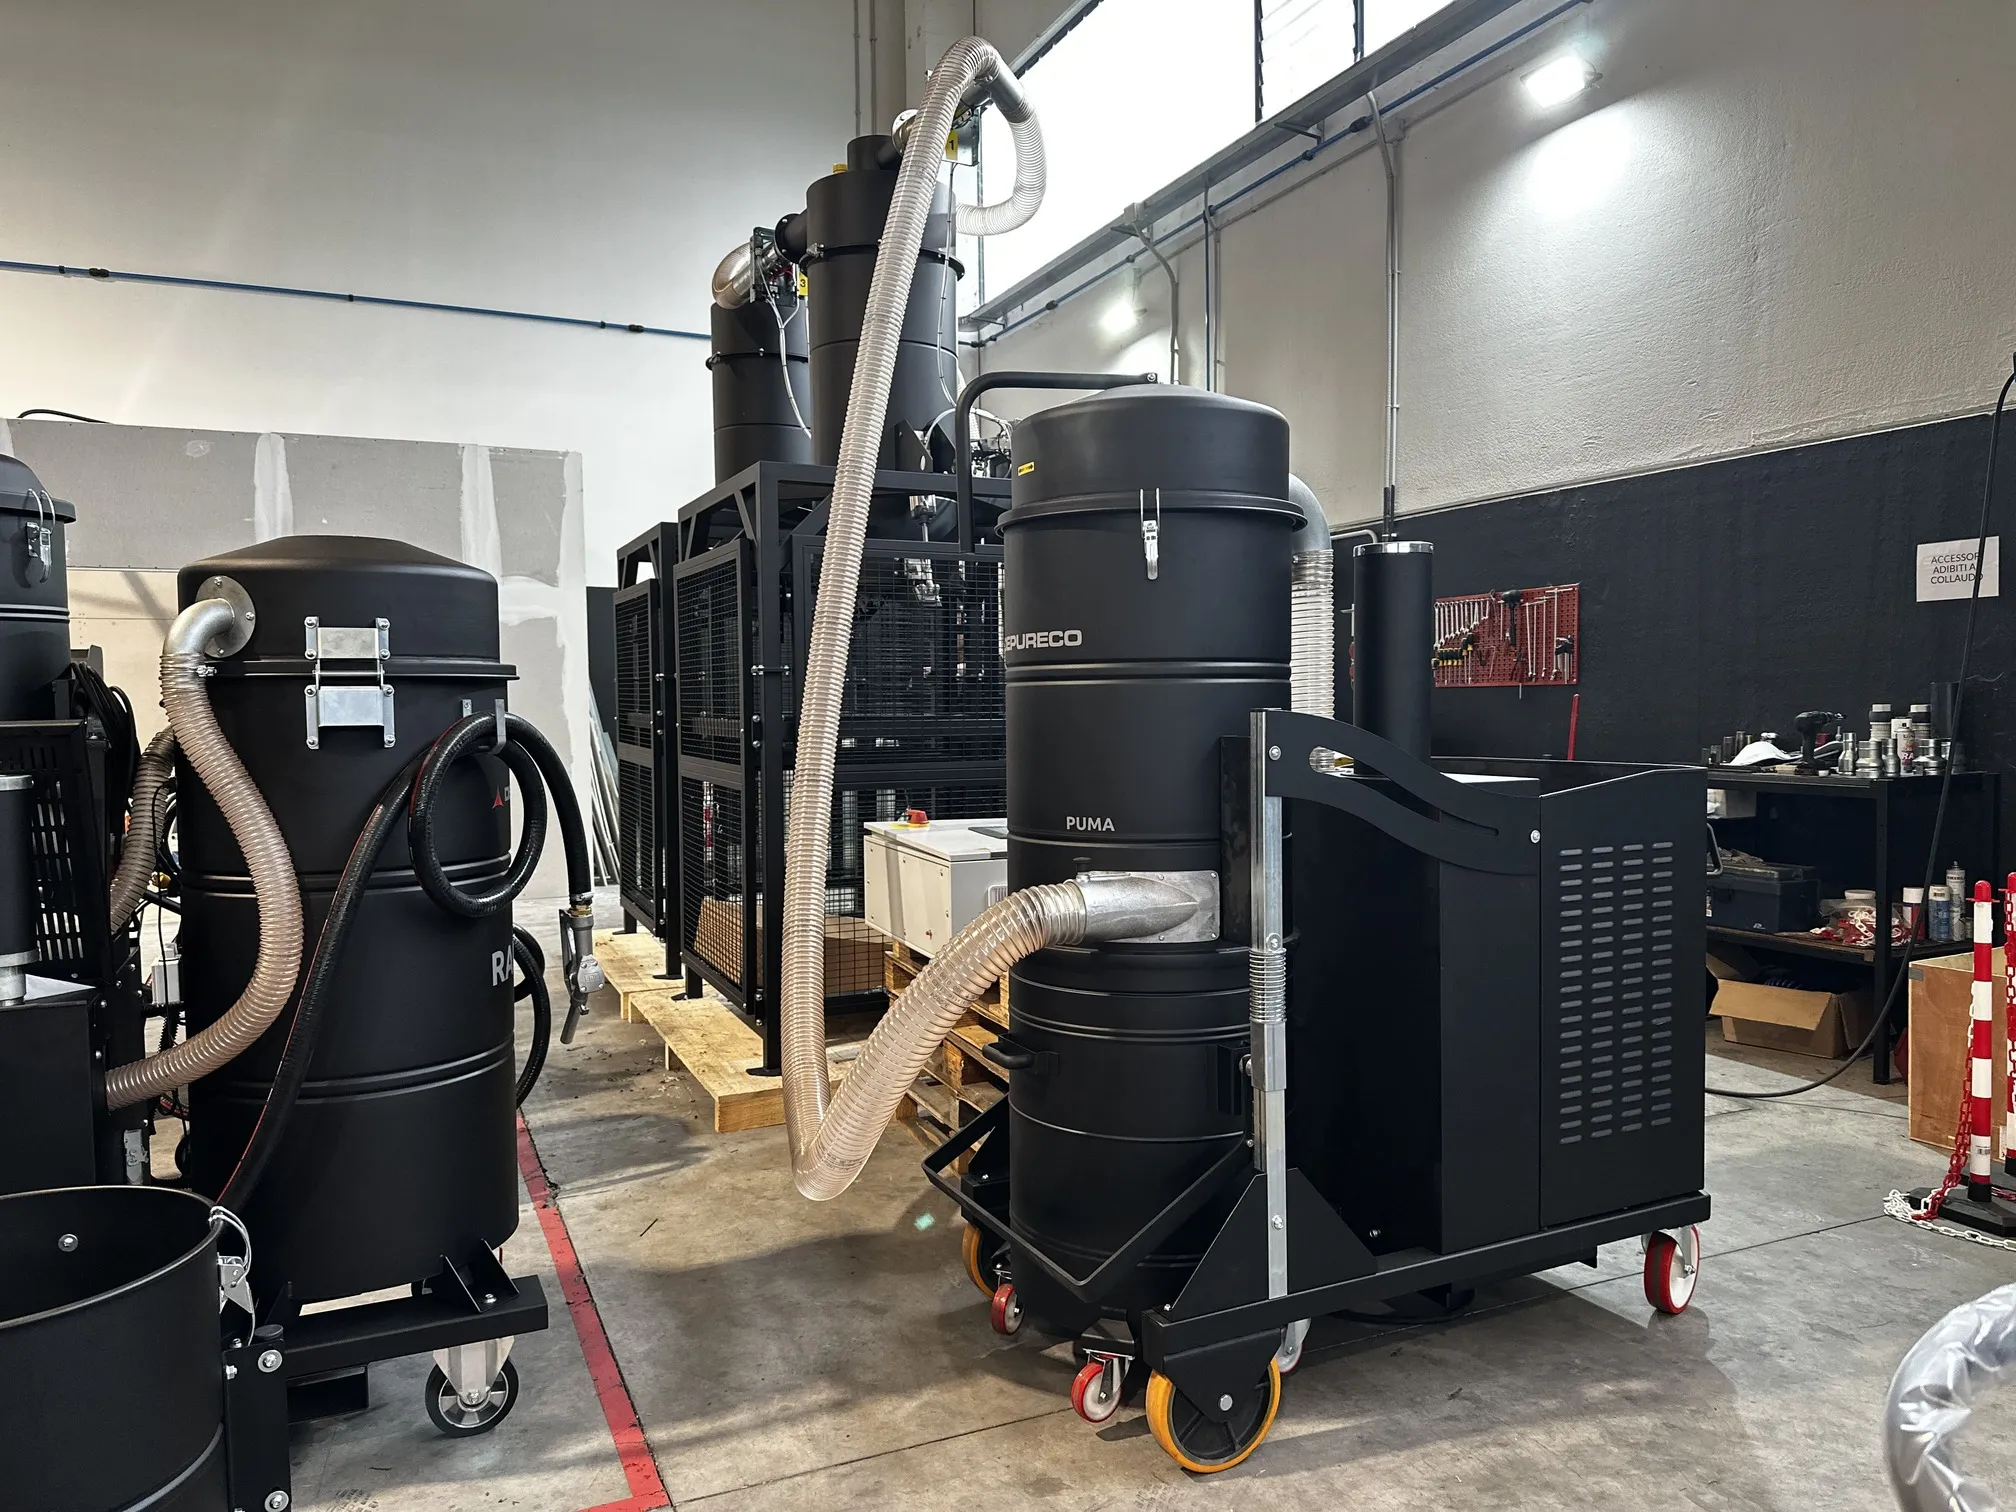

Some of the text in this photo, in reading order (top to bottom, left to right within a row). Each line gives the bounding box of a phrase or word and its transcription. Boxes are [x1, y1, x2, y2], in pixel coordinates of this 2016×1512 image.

[800, 278, 806, 288] 3
[1931, 552, 1979, 565] ACCESSOR
[1933, 563, 1967, 574] ADIBITI
[1004, 629, 1083, 652] EPURECO
[1066, 816, 1116, 832] PUMA
[492, 944, 514, 986] RA
